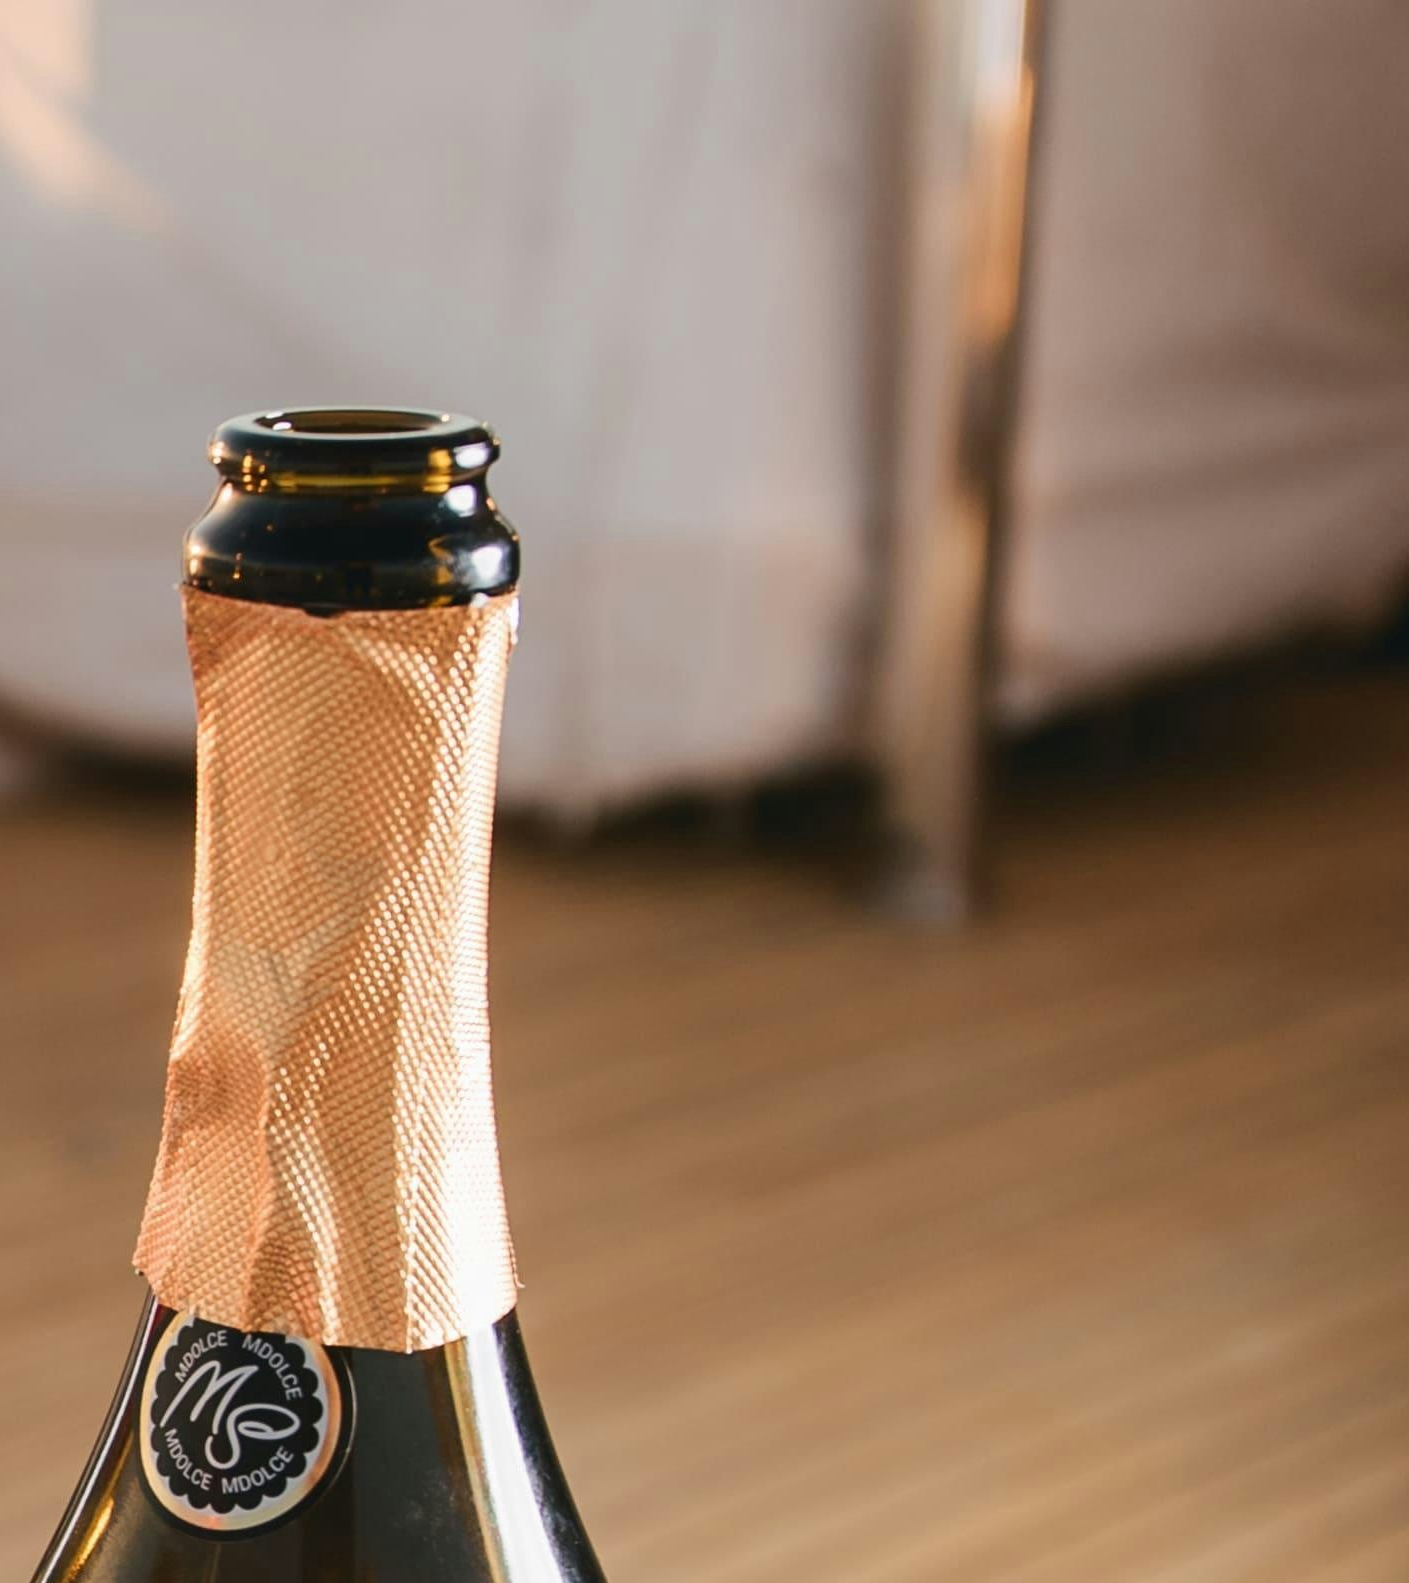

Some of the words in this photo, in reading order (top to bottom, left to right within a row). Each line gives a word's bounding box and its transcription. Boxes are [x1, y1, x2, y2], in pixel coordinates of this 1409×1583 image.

[175, 1330, 228, 1383] MDOLCE
[242, 1334, 302, 1400] MDOLCE
[164, 1428, 213, 1491] MDOLCE
[221, 1446, 295, 1494] MDOLCE
